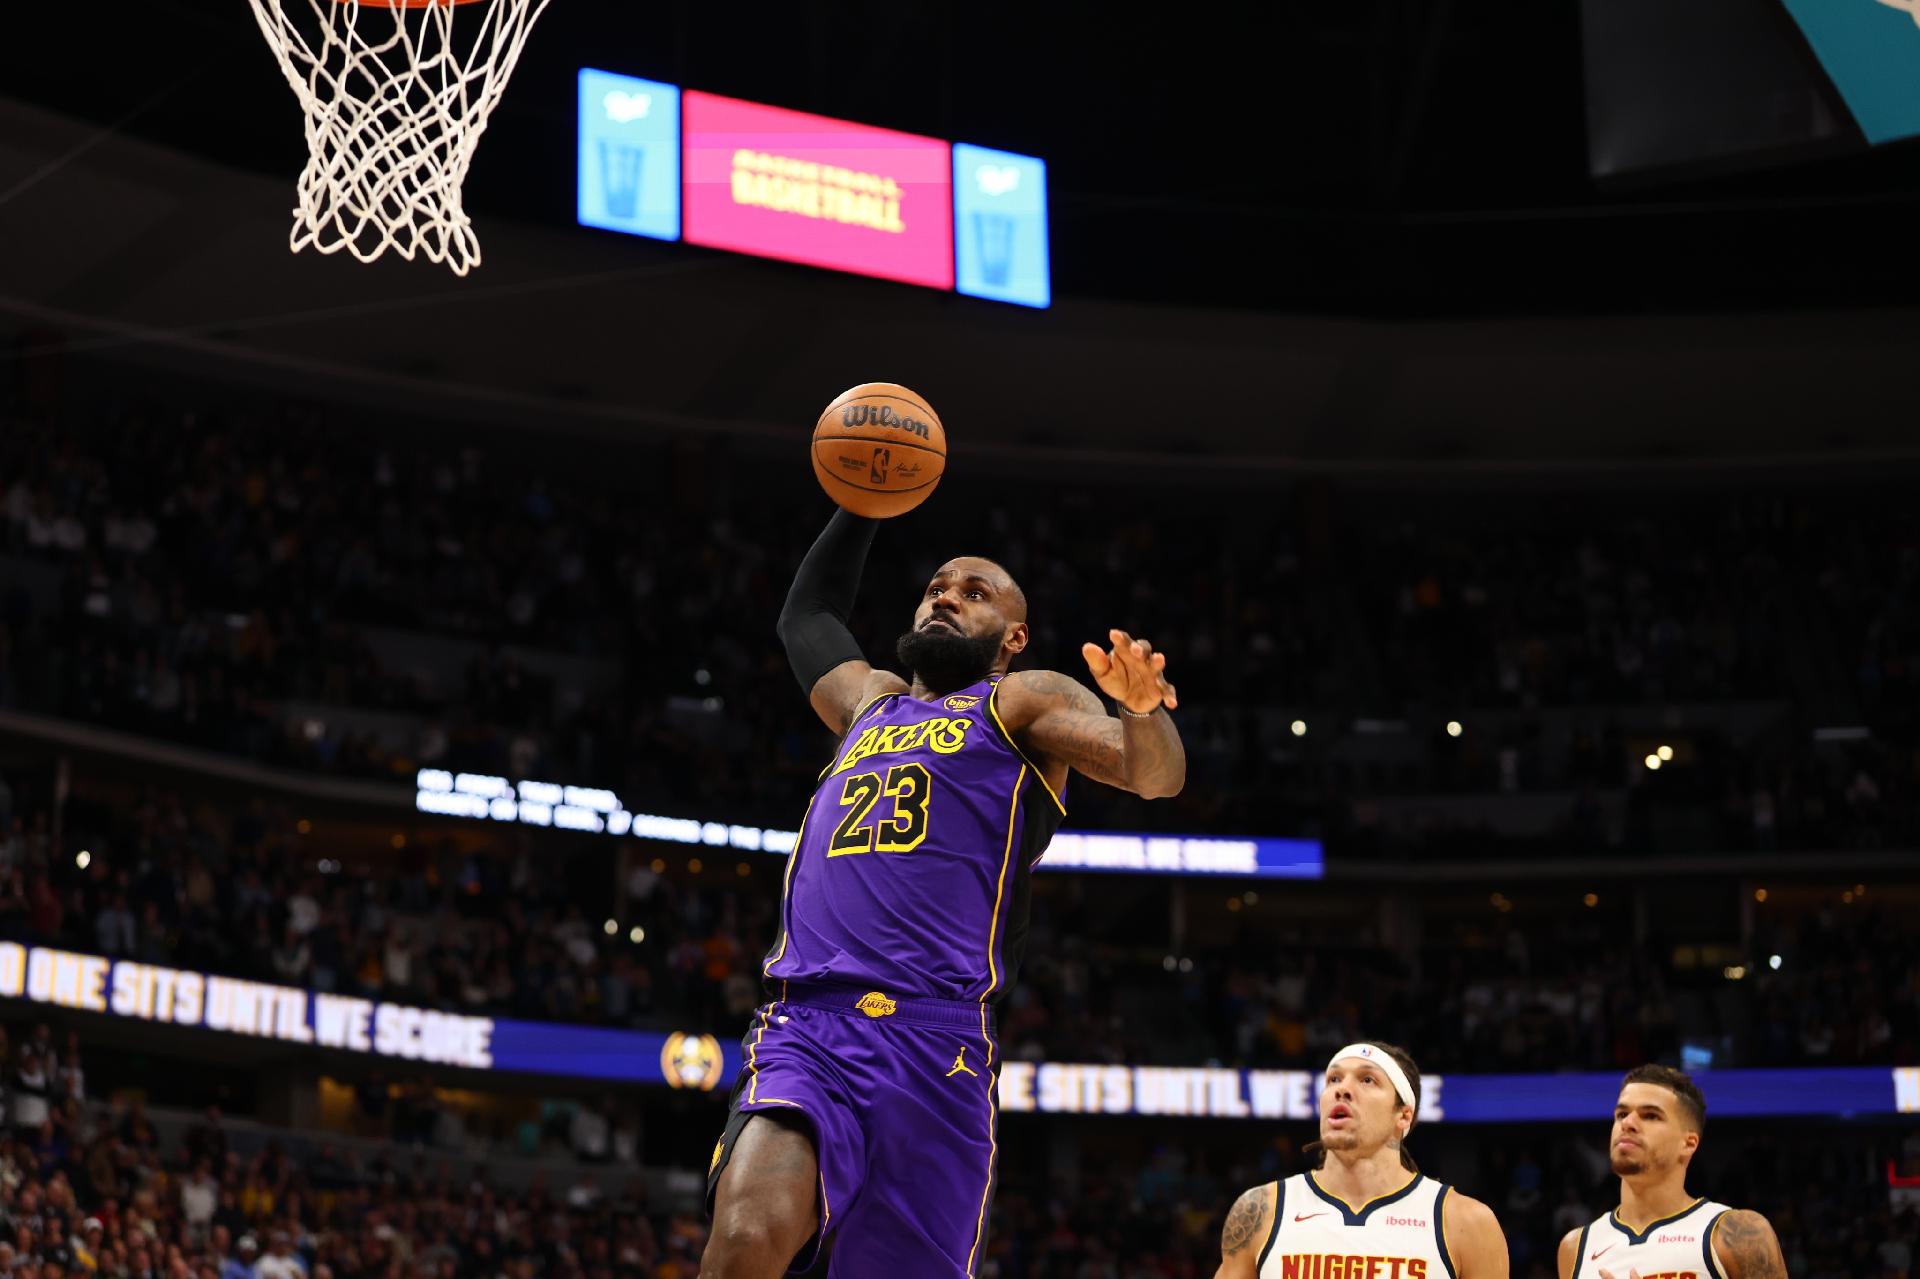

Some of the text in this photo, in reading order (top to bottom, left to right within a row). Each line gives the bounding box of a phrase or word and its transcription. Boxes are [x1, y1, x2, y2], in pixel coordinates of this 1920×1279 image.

[842, 404, 929, 440] Wilson
[831, 718, 974, 777] LAKERS
[827, 762, 932, 858] 23
[28, 947, 110, 1014] ONE
[112, 961, 205, 1026] SITS
[206, 976, 315, 1043] UNTIL
[314, 991, 374, 1051] WE
[374, 1002, 495, 1068] SCORE
[858, 997, 896, 1013] LAKERS
[1038, 1062, 1133, 1114] SITS
[1135, 1066, 1249, 1118] UNTIL
[1249, 1069, 1313, 1119] WE
[1386, 1215, 1427, 1228] ibotta
[1658, 1233, 1696, 1244] ibotta
[1281, 1254, 1428, 1279] NUGGETS
